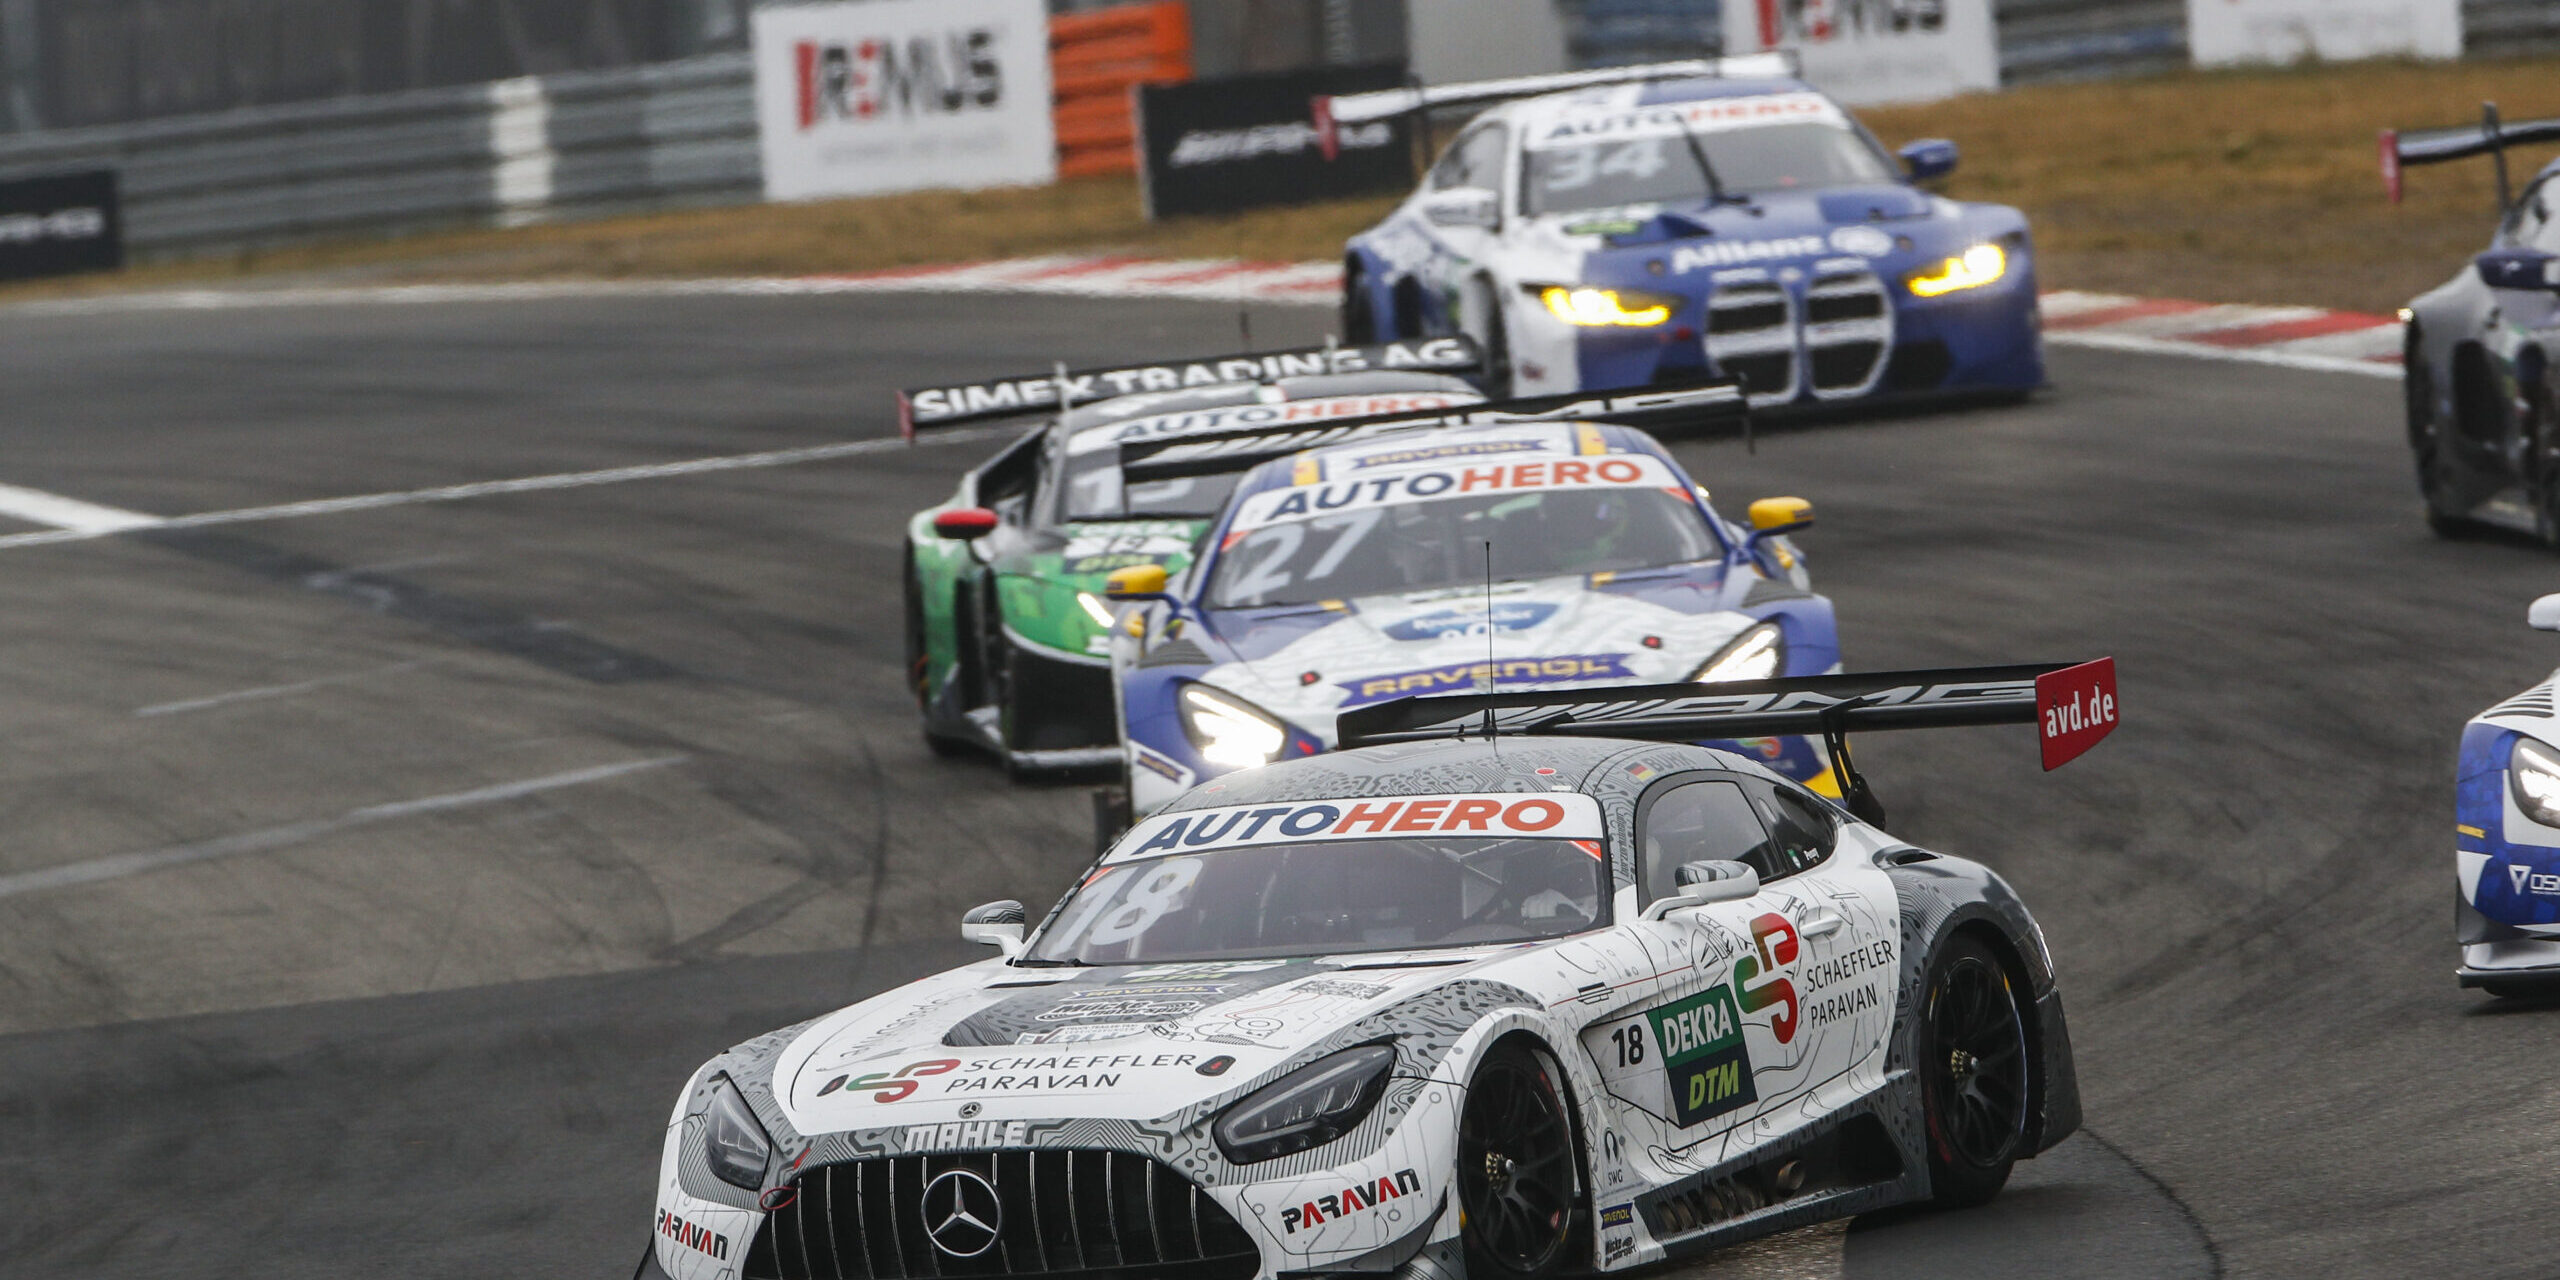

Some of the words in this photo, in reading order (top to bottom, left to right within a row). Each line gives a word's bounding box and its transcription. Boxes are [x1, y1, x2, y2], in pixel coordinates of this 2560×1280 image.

[1545, 139, 1666, 190] 34
[1672, 236, 1823, 275] Allianz
[912, 374, 1096, 419] SIMEX
[1100, 348, 1361, 395] TRADING
[1384, 338, 1466, 367] AG
[1114, 394, 1450, 441] AUTOHERO
[1266, 459, 1643, 520] AUTOHERO
[1226, 508, 1385, 604] 27
[1361, 658, 1611, 696] RAVENOL
[2046, 685, 2115, 738] avd.de
[1131, 799, 1565, 856] AUTOHERO
[1047, 857, 1204, 958] 18
[1806, 940, 1896, 993] SCHAEFFLER
[1662, 998, 1734, 1058] DEKRA
[1810, 983, 1878, 1029] PARAVAN
[964, 1054, 1196, 1074] SCHAEFFLER
[1611, 1024, 1644, 1068] 18
[945, 1073, 1121, 1093] PARAVAN
[1688, 1059, 1739, 1112] DTM
[904, 1121, 1027, 1151] MAHLE
[1281, 1168, 1421, 1234] PARAVAN
[1608, 1169, 1623, 1187] SWG
[657, 1207, 728, 1260] PARAVAN
